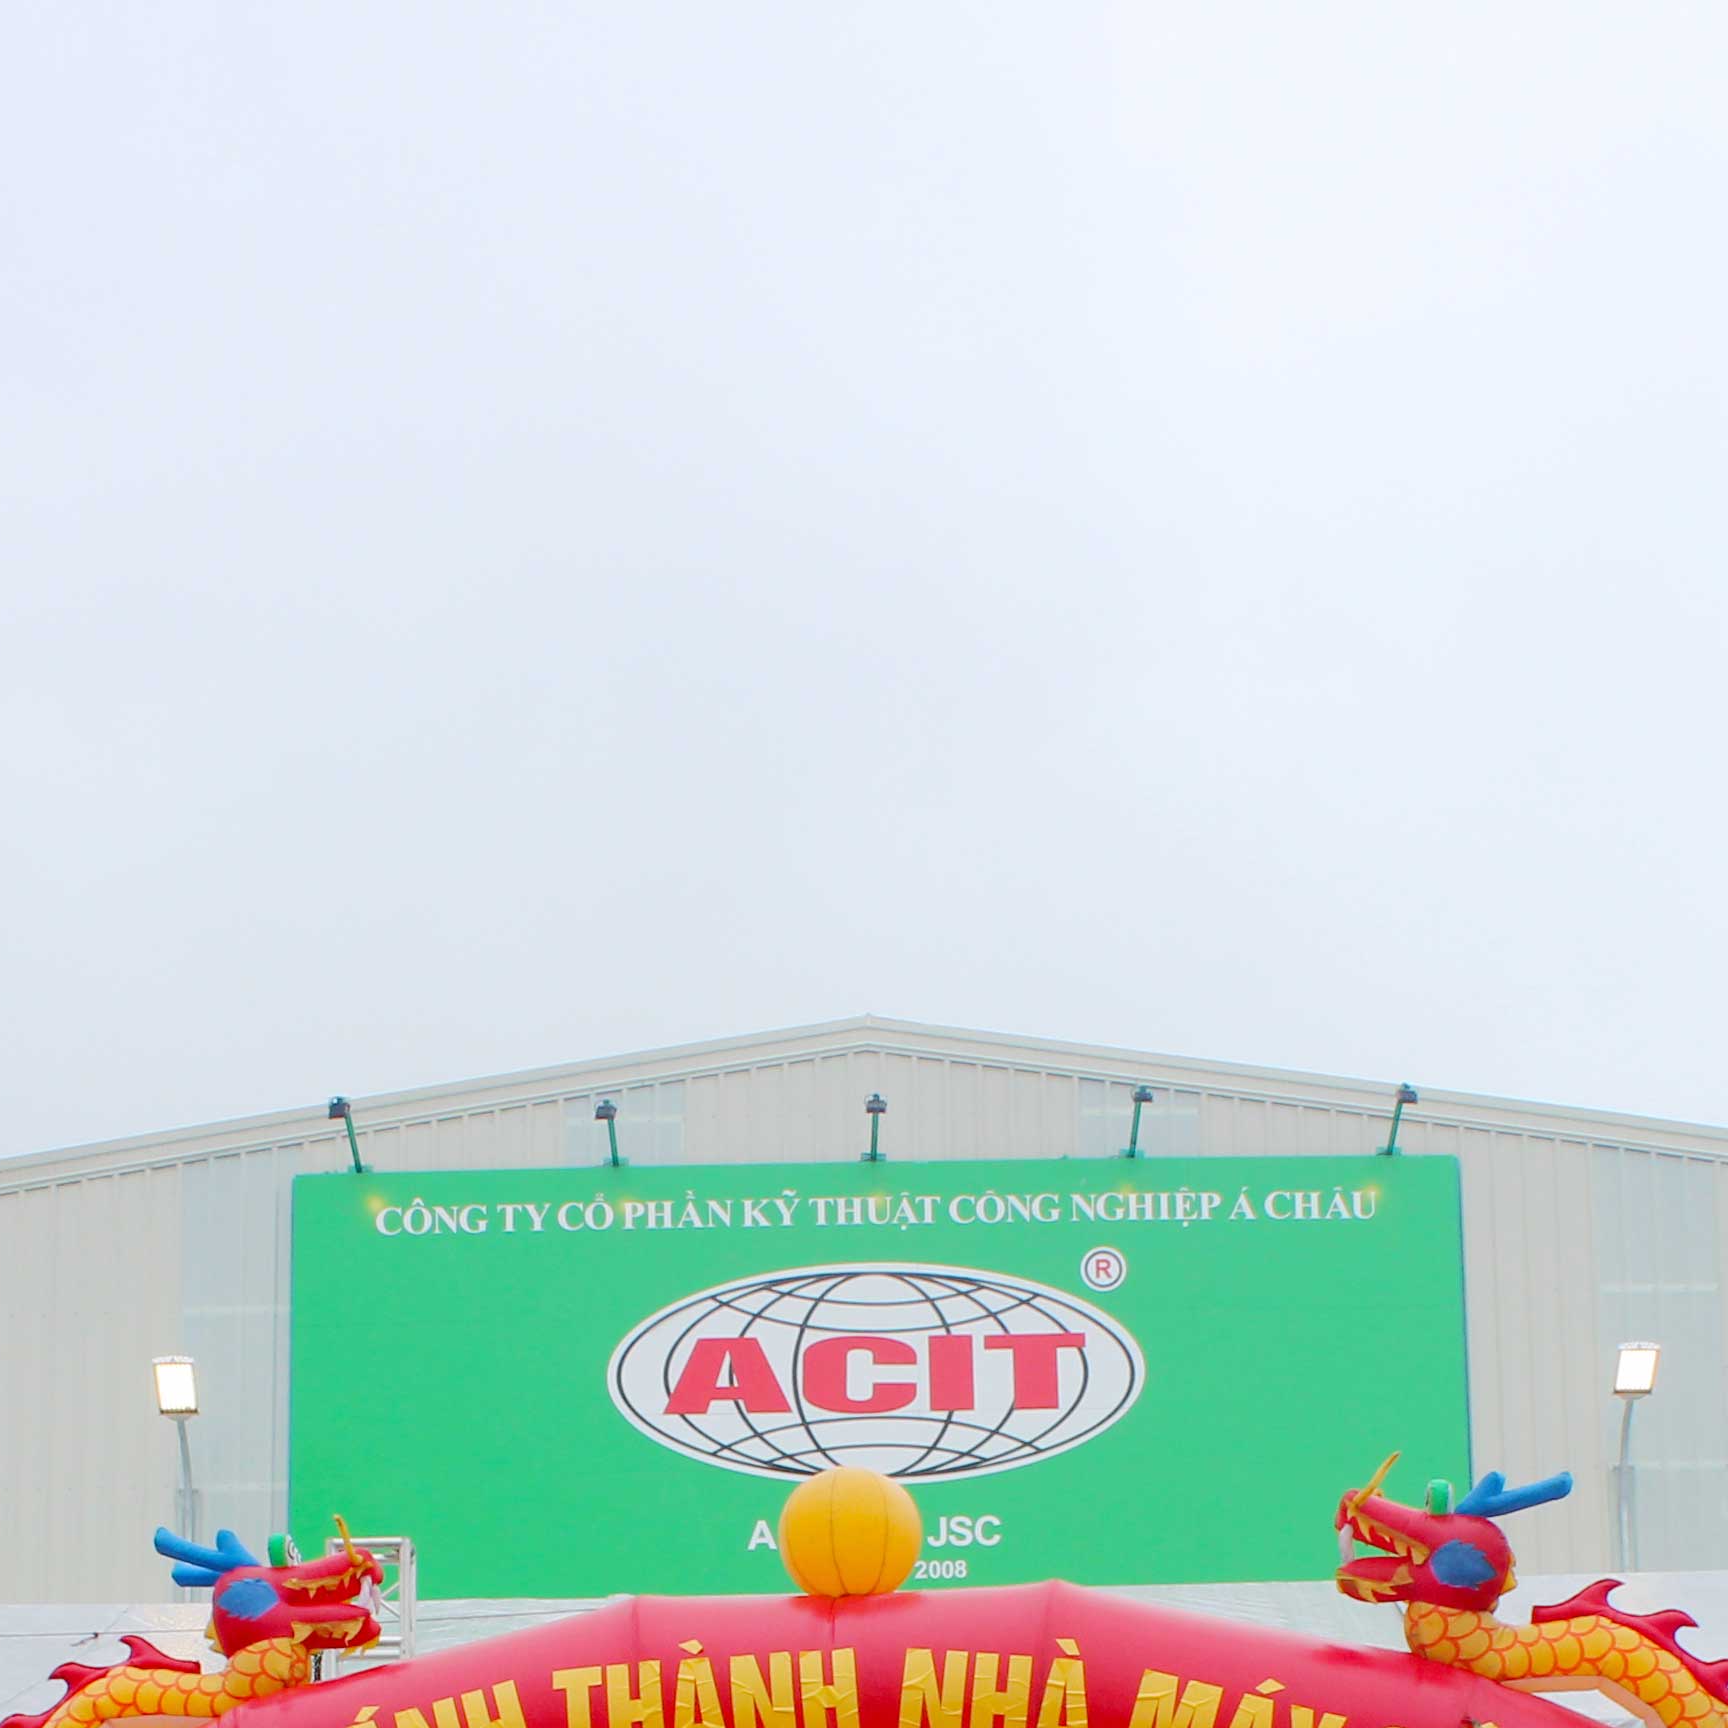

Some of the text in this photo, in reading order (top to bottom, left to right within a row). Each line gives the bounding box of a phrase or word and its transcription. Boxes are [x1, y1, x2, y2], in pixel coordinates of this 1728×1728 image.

[375, 1197, 488, 1235] CÔNG
[497, 1202, 551, 1233] TY
[623, 1190, 732, 1230] PHẦN
[742, 1189, 801, 1228] KỸ
[809, 1190, 940, 1231] THUẬT
[949, 1190, 1060, 1224] CÔNG
[1070, 1187, 1221, 1228] NGHIỆP
[1229, 1186, 1256, 1221] Á
[1264, 1186, 1377, 1220] CHÂU
[663, 1333, 1085, 1414] ACIT
[927, 1515, 1001, 1546] JSC
